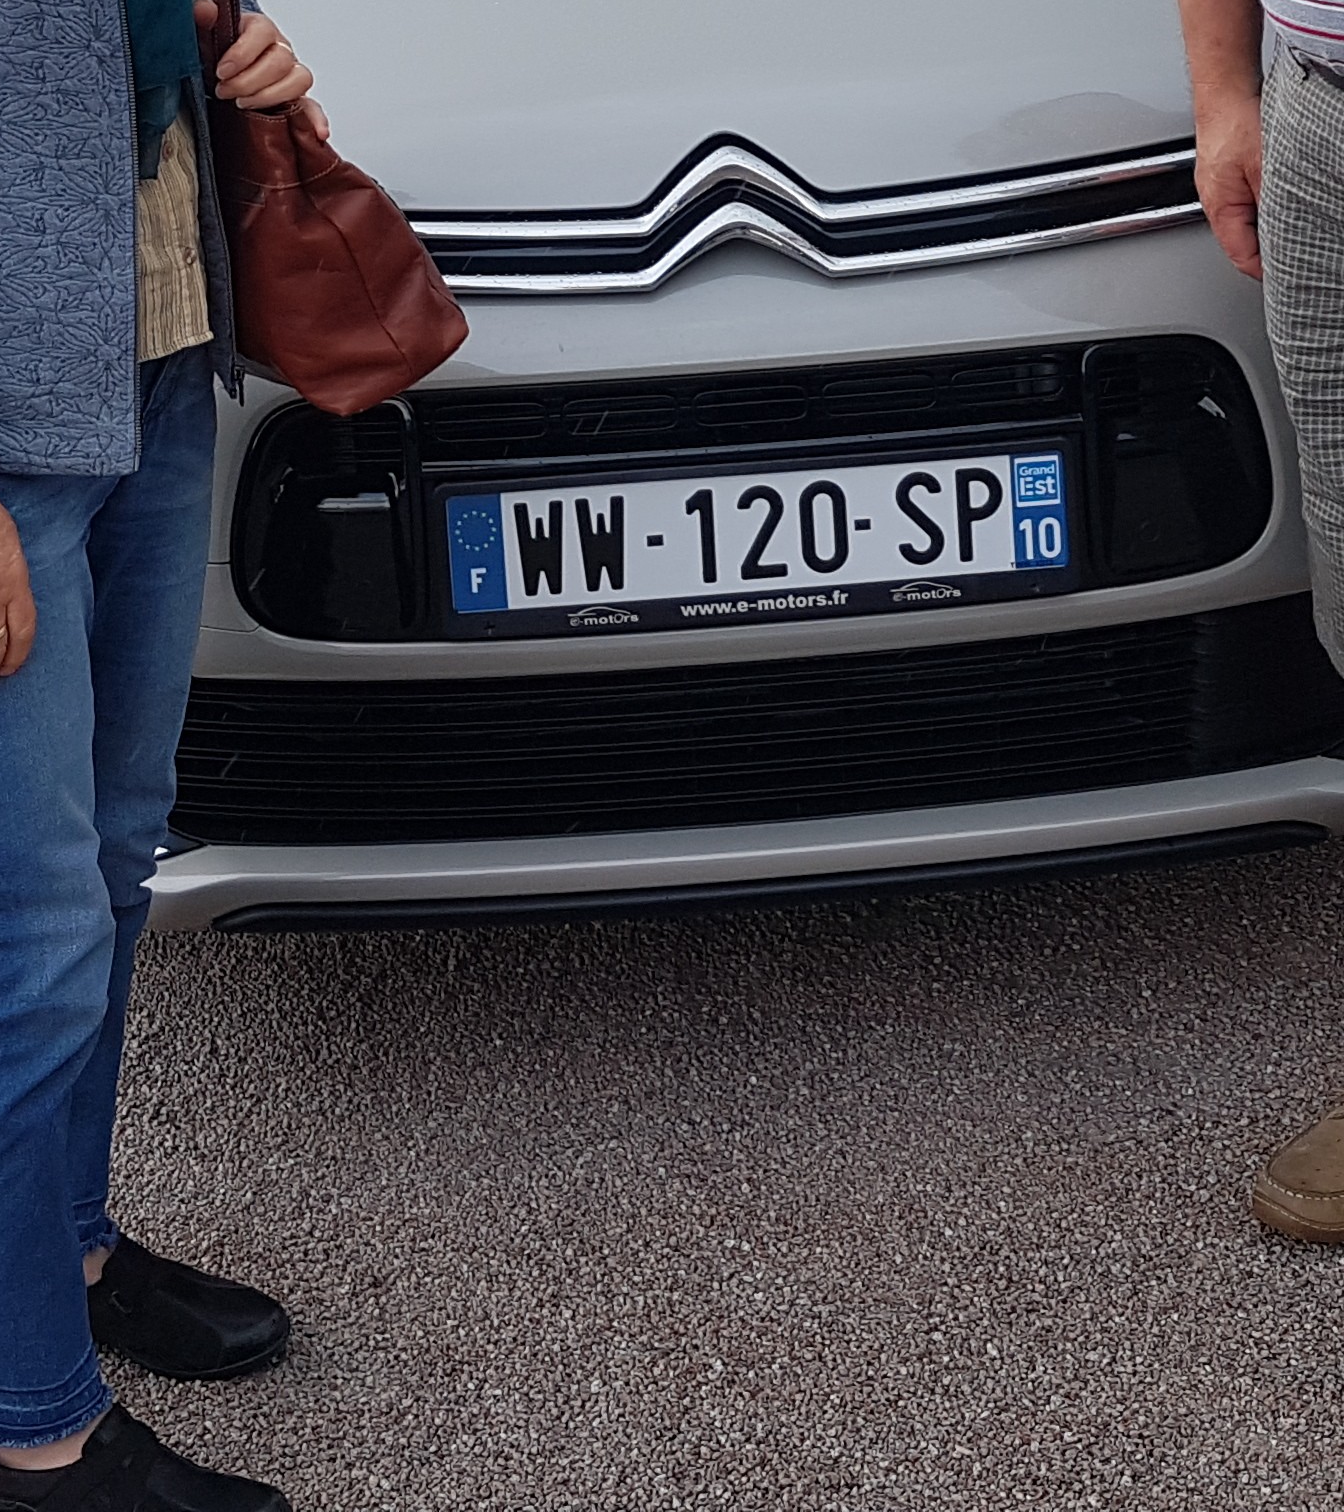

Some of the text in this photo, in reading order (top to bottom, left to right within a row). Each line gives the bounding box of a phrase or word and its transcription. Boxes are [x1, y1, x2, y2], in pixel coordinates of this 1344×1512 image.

[1019, 463, 1056, 476] Grand
[1019, 475, 1056, 496] Est
[1019, 516, 1062, 560] 10
[470, 567, 487, 594] F
[680, 589, 850, 617] www.e-motors.fr
